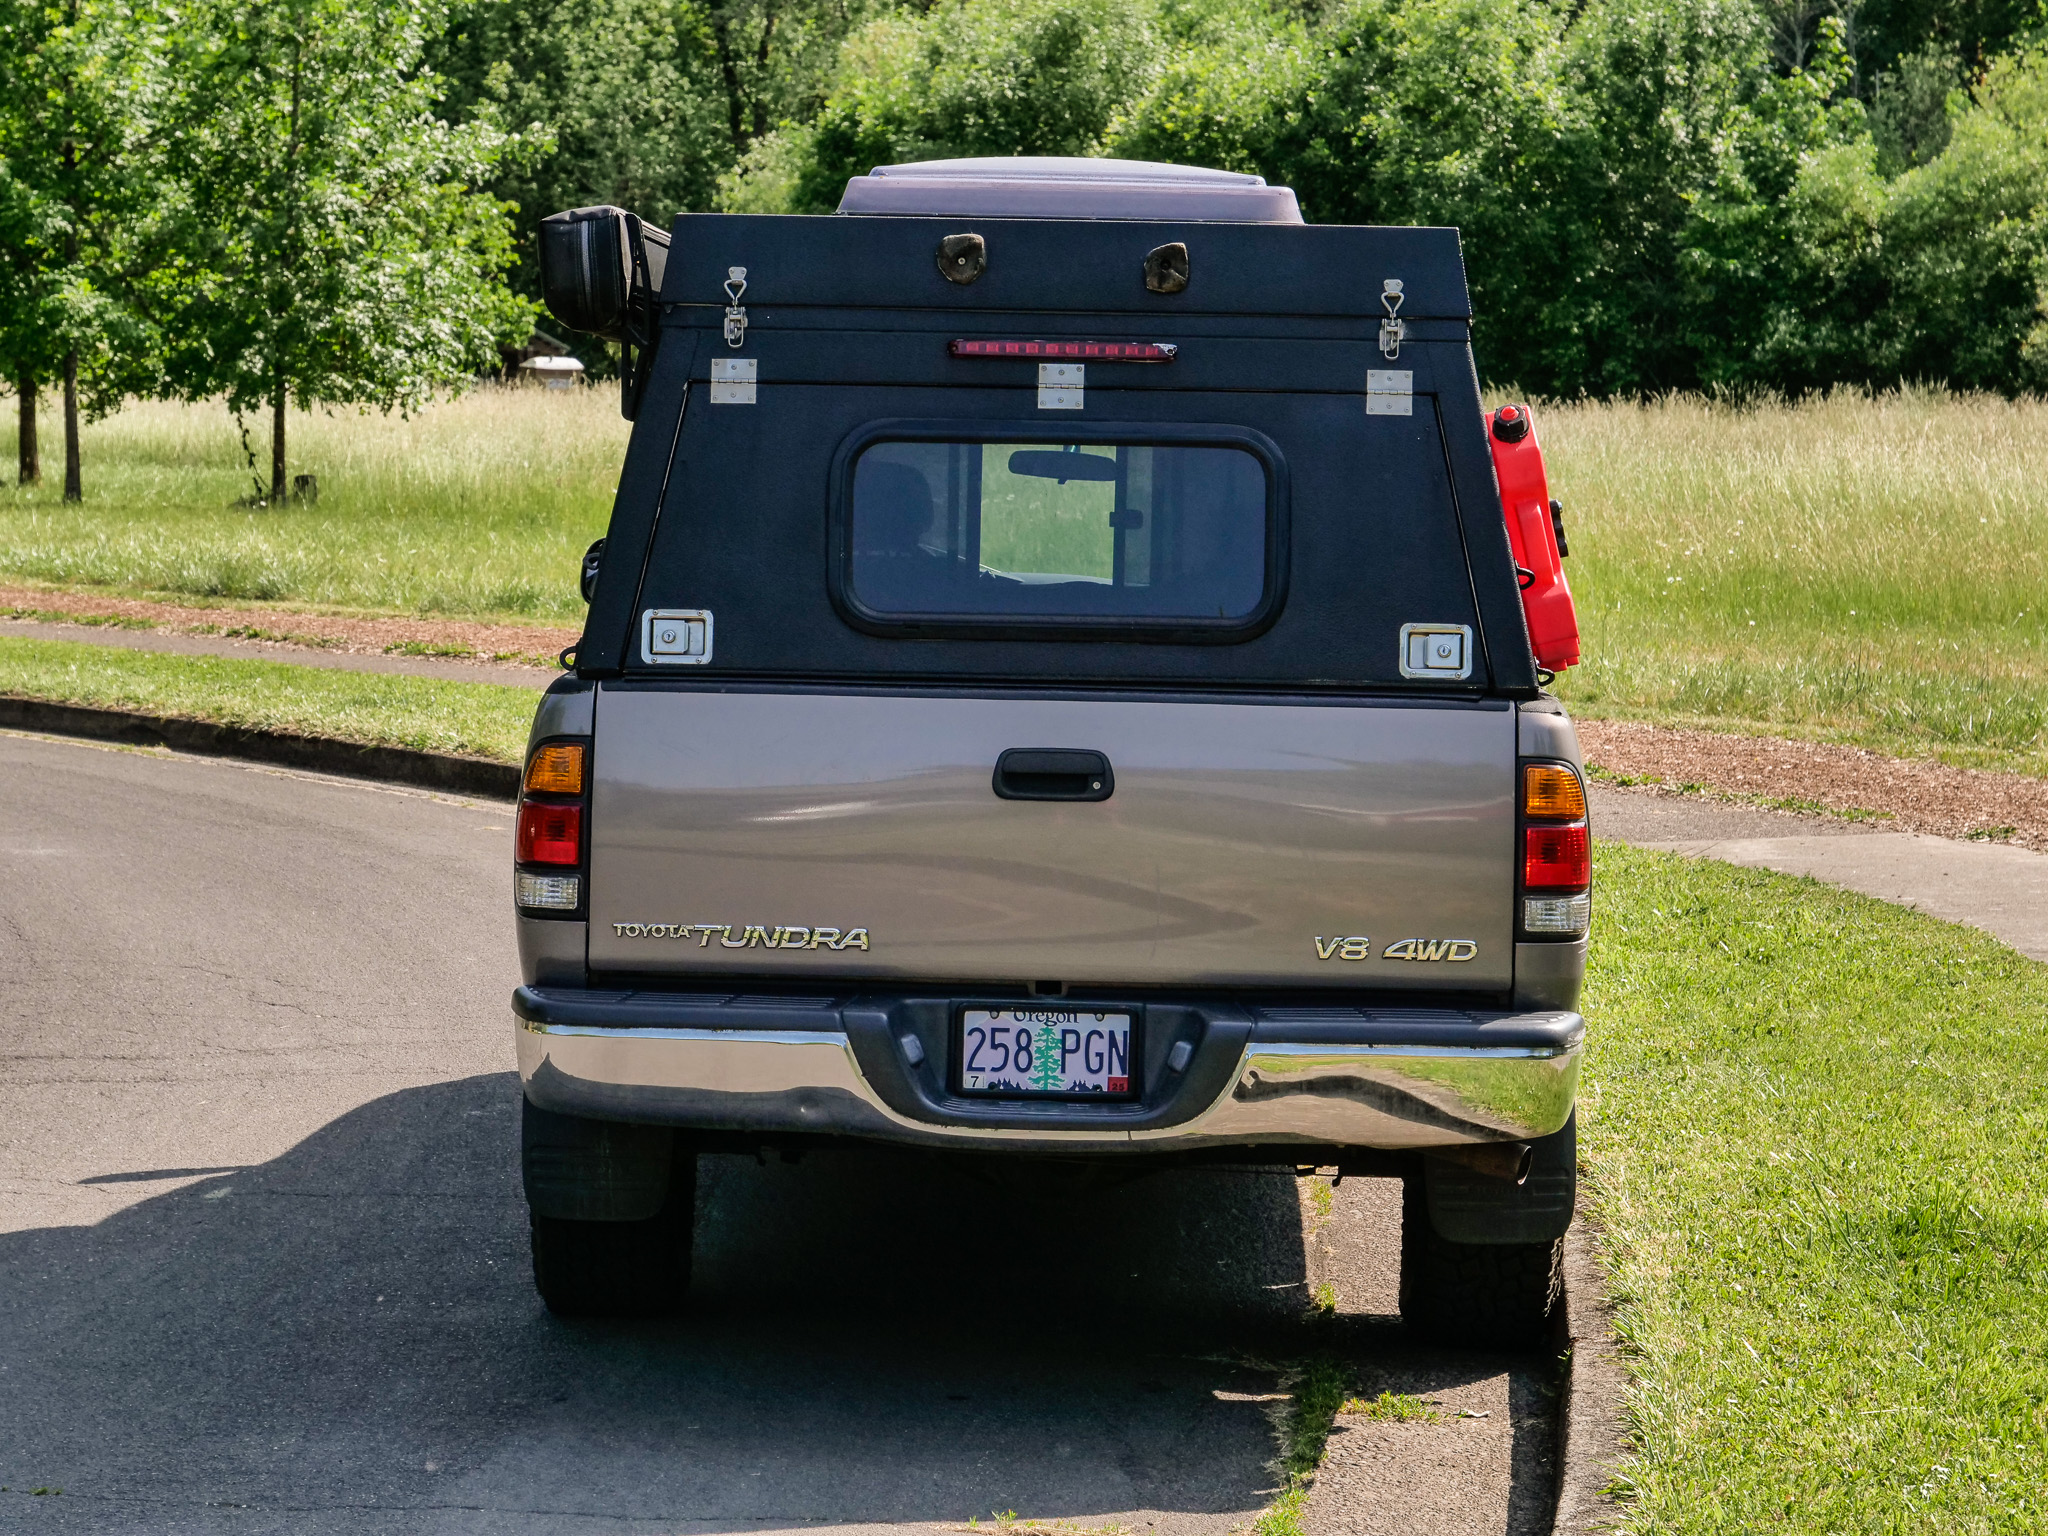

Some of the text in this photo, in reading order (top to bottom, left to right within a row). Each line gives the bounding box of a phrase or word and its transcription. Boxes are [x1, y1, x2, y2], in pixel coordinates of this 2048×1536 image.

[613, 922, 869, 951] TOYOTA TUNDRA
[1314, 936, 1478, 962] V8 4WD
[1013, 1011, 1079, 1027] Oregon
[966, 1027, 1128, 1076] 258 PGN
[970, 1076, 980, 1088] 7
